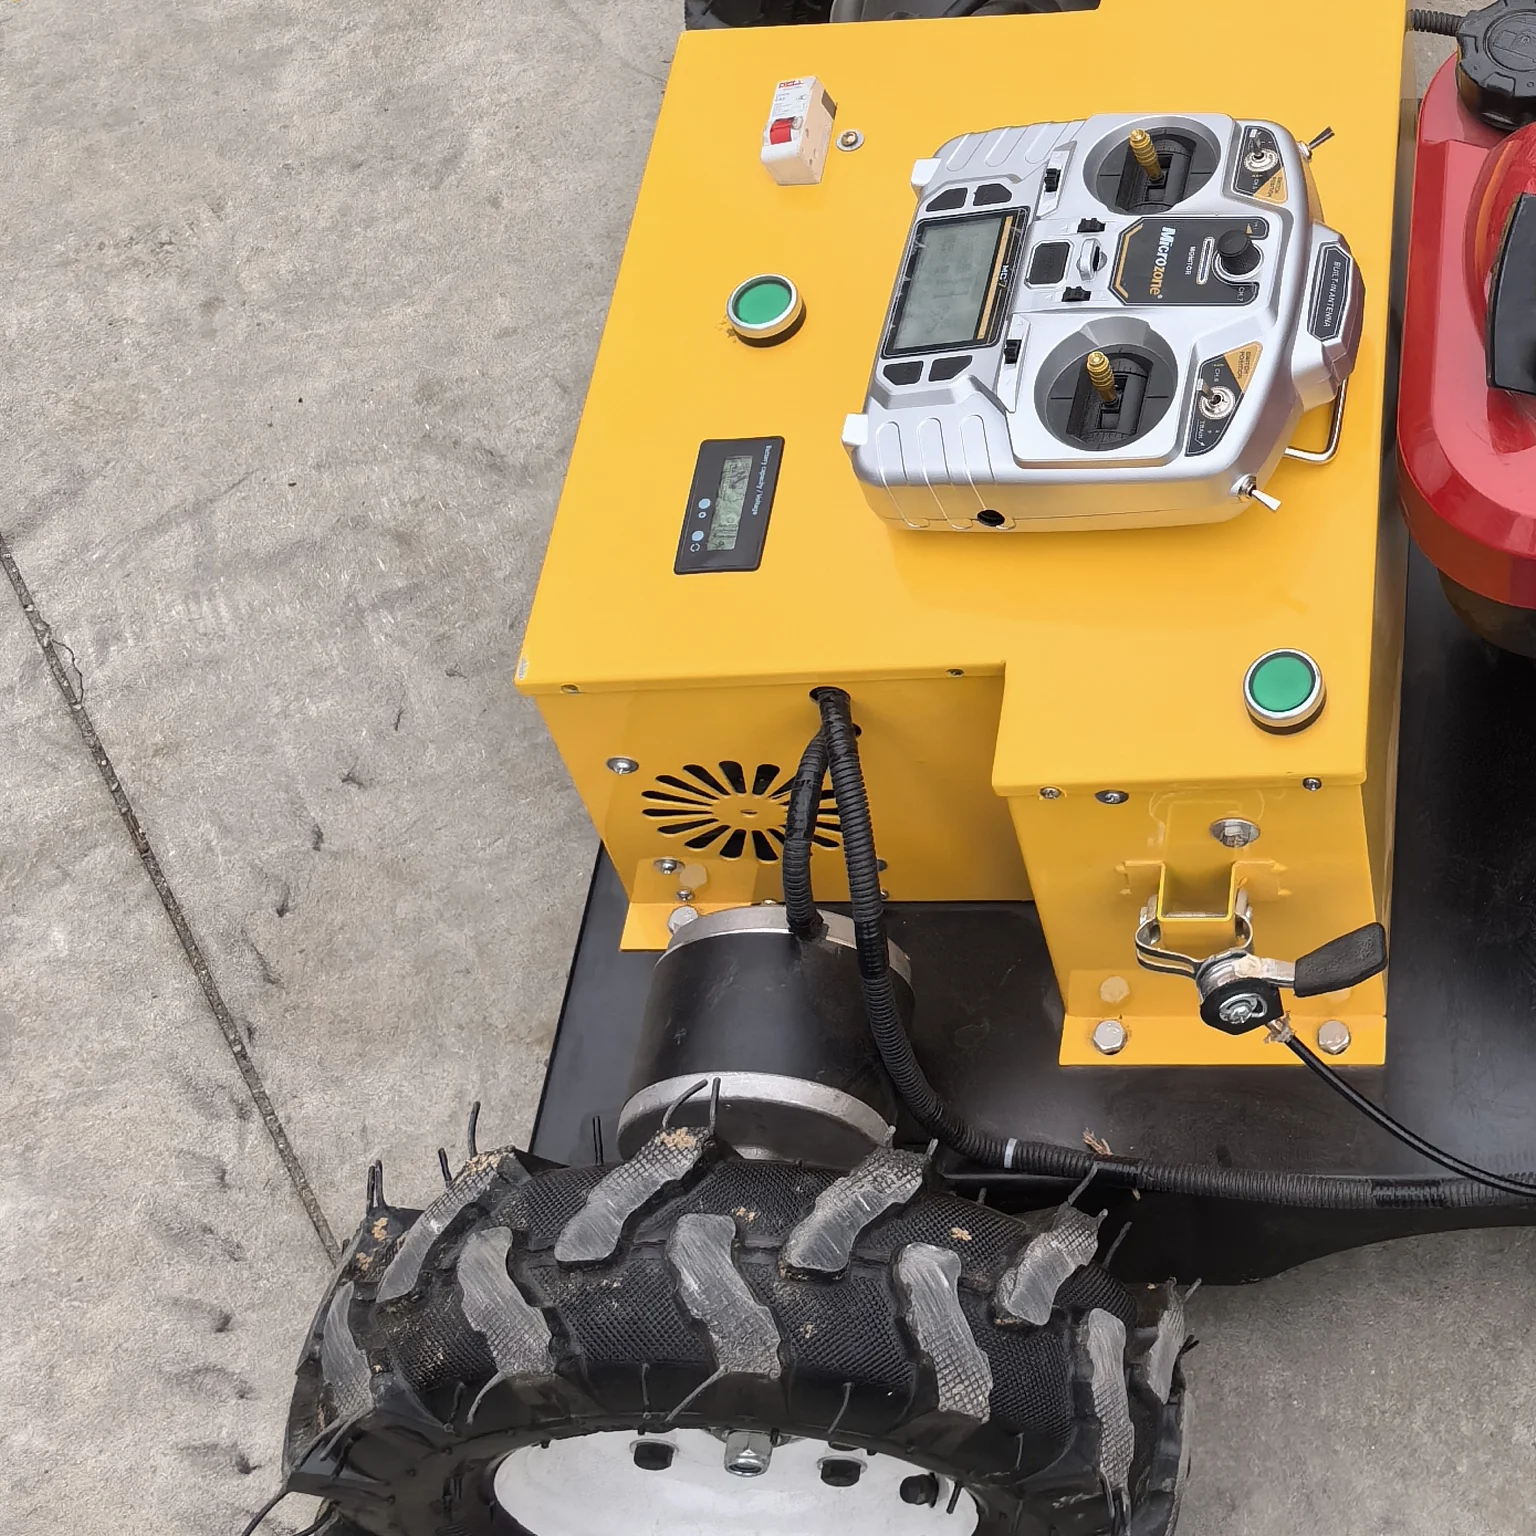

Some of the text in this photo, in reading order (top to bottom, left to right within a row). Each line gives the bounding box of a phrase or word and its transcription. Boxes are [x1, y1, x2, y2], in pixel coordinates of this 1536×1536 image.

[1149, 226, 1176, 297] Microzone
[1184, 245, 1197, 275] MONITOR
[1323, 261, 1342, 328] BUILT-IN ANTENNA
[761, 445, 772, 465] Battery
[756, 466, 766, 489] capacity
